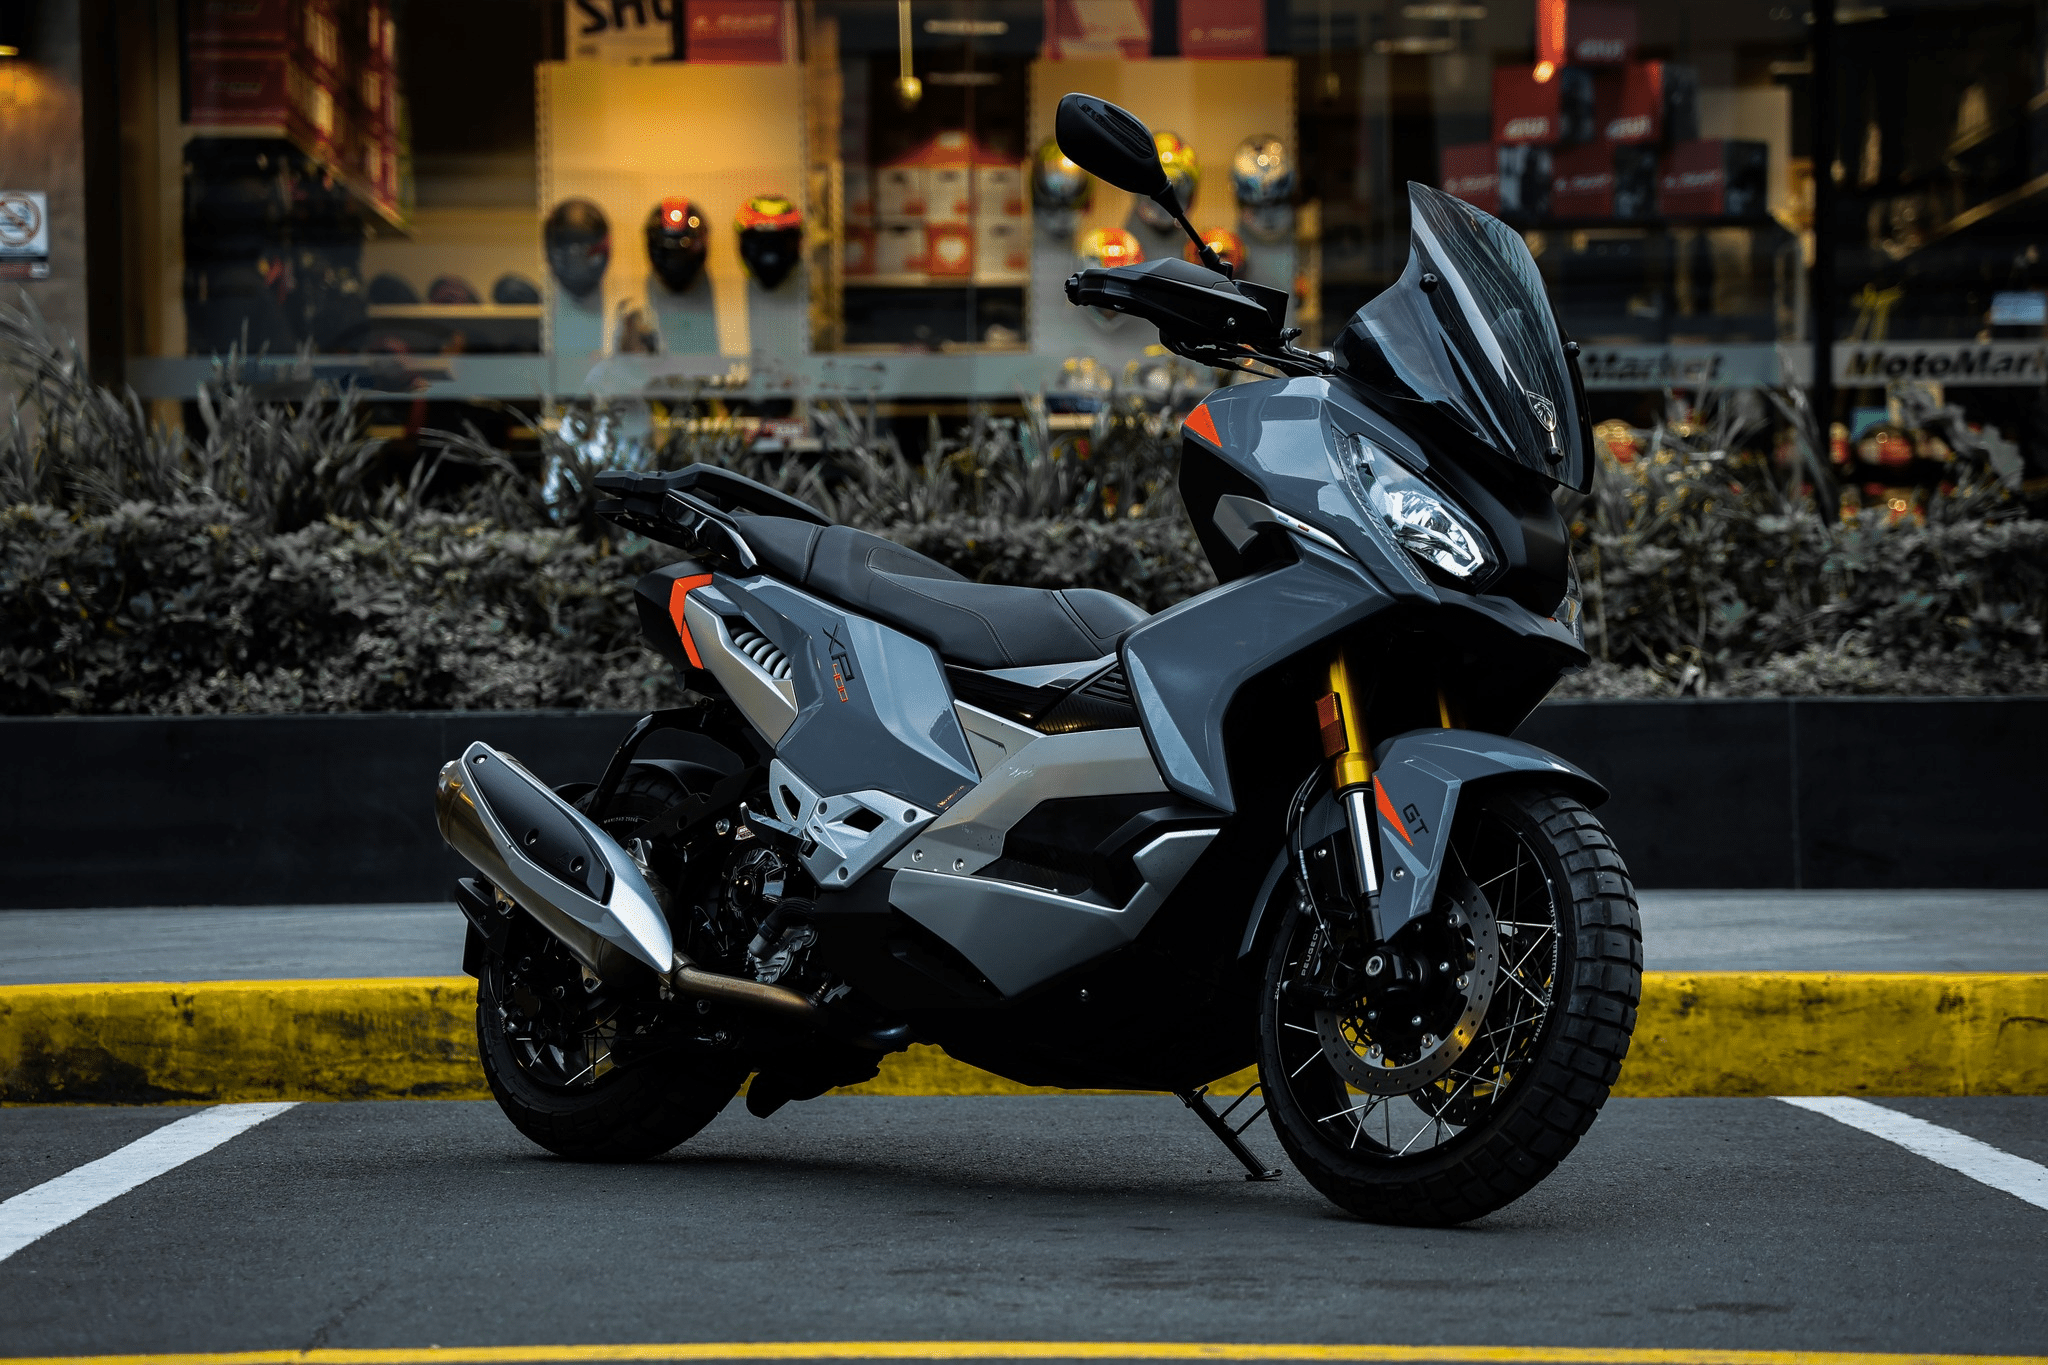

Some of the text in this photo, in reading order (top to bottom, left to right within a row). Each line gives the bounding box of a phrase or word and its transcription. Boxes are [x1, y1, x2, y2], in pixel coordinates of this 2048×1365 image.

[822, 622, 855, 682] XP
[1402, 803, 1429, 834] GT
[1301, 925, 1320, 976] PEUGEOT
